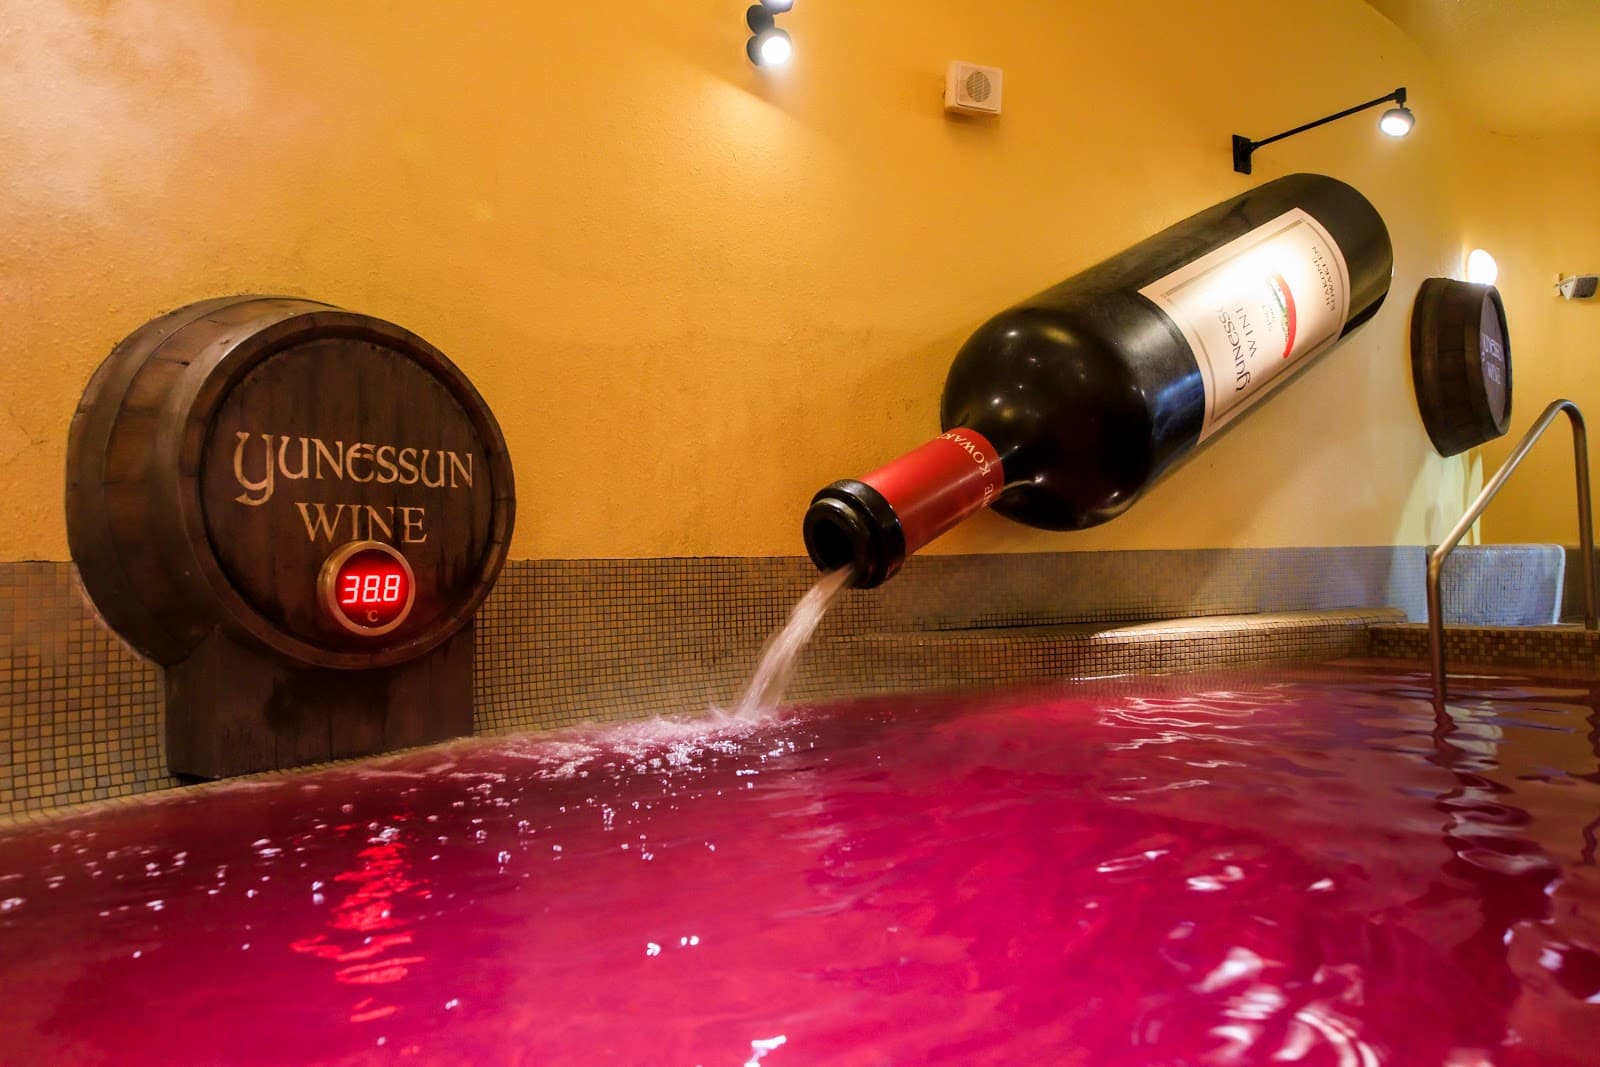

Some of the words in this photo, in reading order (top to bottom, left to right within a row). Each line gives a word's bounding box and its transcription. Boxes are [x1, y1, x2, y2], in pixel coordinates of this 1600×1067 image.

[233, 431, 474, 507] YUNESSUN
[294, 502, 428, 544] WINE
[342, 574, 401, 605] 38.8
